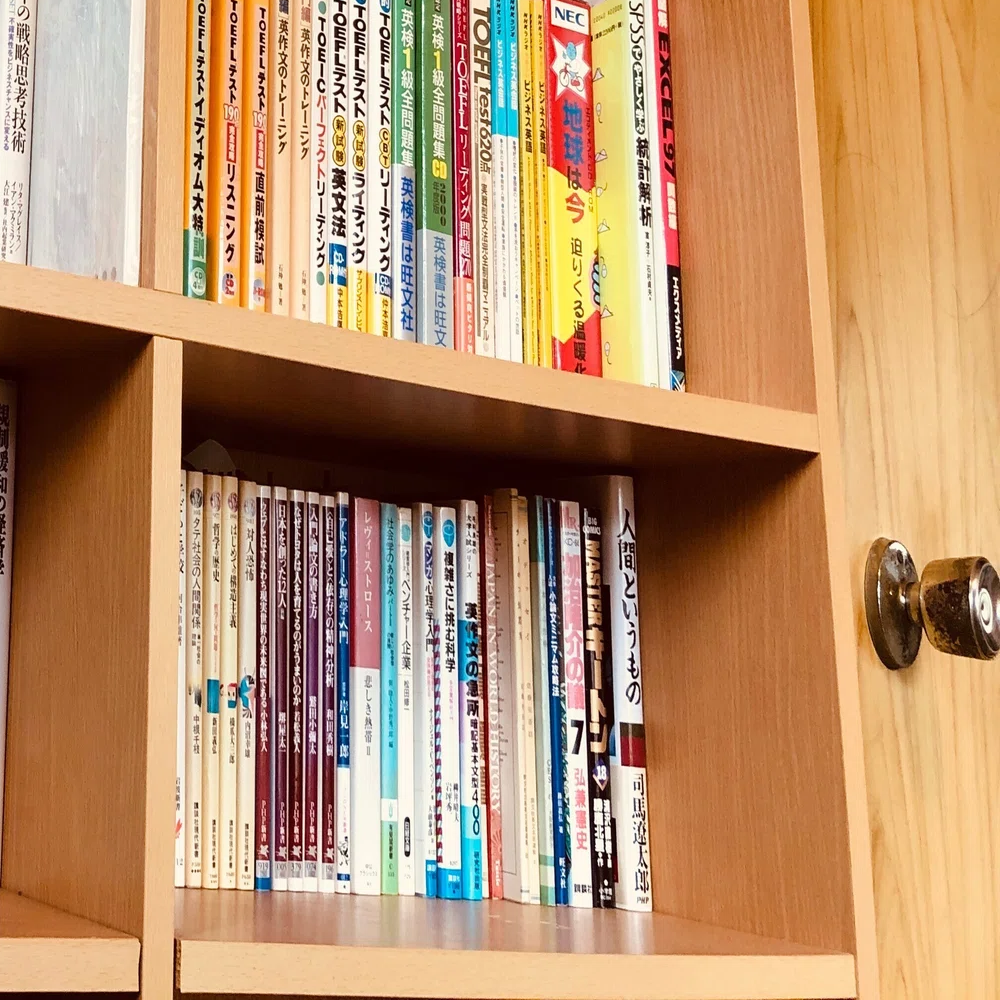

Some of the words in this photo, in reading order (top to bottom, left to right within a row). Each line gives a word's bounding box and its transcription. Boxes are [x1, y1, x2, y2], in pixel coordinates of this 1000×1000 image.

[228, 0, 239, 104] TOEFLテスト
[316, 16, 327, 94] TOEIC
[332, 0, 347, 113] TOEFLテスト
[472, 7, 491, 85] TOEFL
[554, 6, 586, 27] NEC
[352, 4, 366, 119] TOEFLテスト
[379, 12, 391, 126] TOEFLテスト
[400, 8, 414, 167] 英検1級全問題集
[431, 13, 446, 160] 英検1級全問題集
[478, 85, 491, 123] test
[315, 94, 327, 179] パーフェクト
[332, 115, 346, 167] 新試験
[353, 120, 366, 171] 新試験
[379, 127, 390, 168] CBT
[431, 158, 448, 180] CD
[225, 164, 236, 263] リスニング
[254, 171, 266, 266] 直前模試
[315, 180, 326, 268] リーディング
[331, 167, 347, 238] 英文法
[351, 172, 366, 264] ライティング
[378, 168, 391, 273] リーディング
[439, 182, 447, 227] 2000
[400, 176, 414, 332] 英検書は旺文社
[433, 236, 447, 348] 英検書は旺文
[192, 517, 201, 629] タテ社会の人間関係
[245, 528, 255, 582] 対人恐怖
[338, 517, 349, 645] アドラー心理学入門
[386, 517, 395, 596] 社会学のあゆみ
[584, 540, 602, 626] MASTER
[401, 579, 412, 671] ベンチャー企業
[443, 550, 456, 673] 複雑さに挑む科学
[617, 508, 641, 705] 人間というもの
[464, 602, 479, 717] 英作文の急所
[260, 709, 268, 753] 小林弘人
[339, 699, 349, 758] 岸見一郎
[570, 719, 585, 755] 7
[573, 767, 588, 850] 弘兼憲史
[596, 765, 607, 781] 18
[632, 774, 650, 894] 司馬遼太郎
